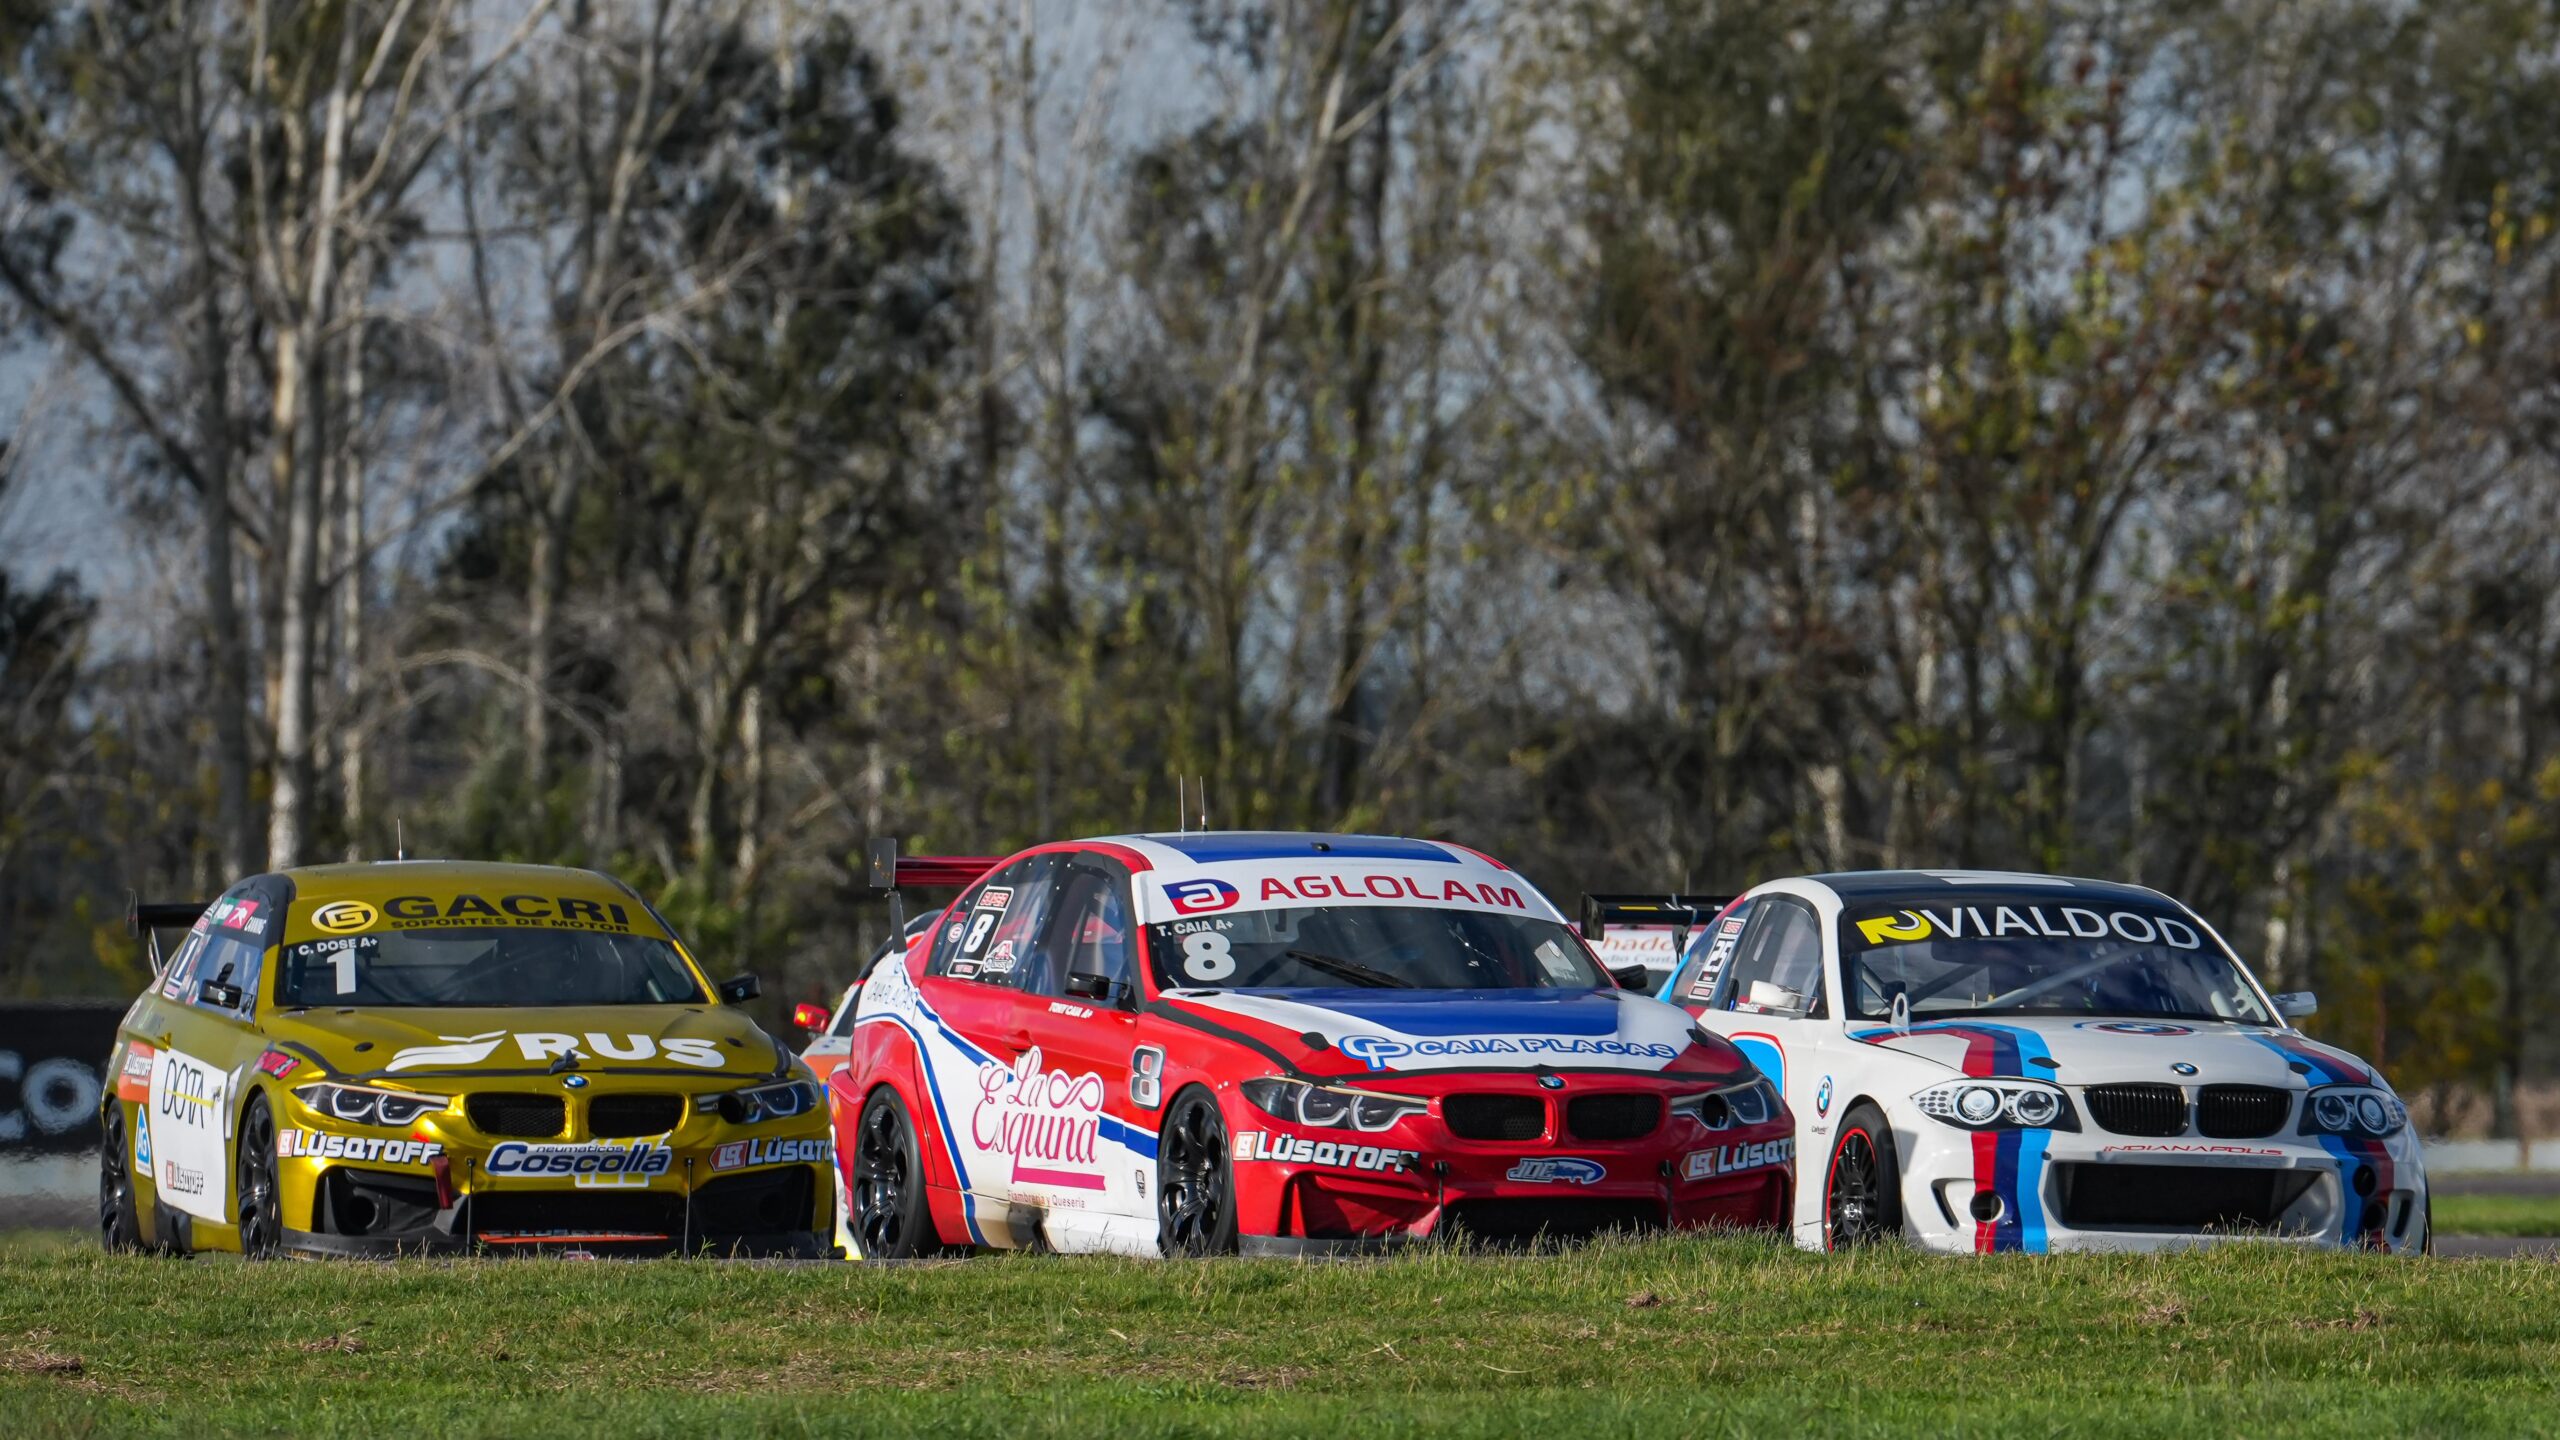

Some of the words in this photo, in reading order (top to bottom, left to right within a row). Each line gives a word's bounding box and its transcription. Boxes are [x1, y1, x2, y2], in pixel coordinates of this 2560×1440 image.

[383, 894, 629, 925] GACRI
[1261, 875, 1526, 909] AGLOLAM
[391, 917, 508, 929] SOPORTES
[515, 918, 545, 926] DE
[551, 919, 630, 932] MOTOR
[963, 913, 995, 953] 8
[1156, 926, 1172, 937] T.
[1174, 920, 1213, 935] CAIA
[1216, 919, 1234, 931] A+
[1920, 906, 2200, 950] VIALDOD
[298, 945, 315, 956] C.
[317, 938, 357, 953] DOSE
[360, 937, 378, 948] A+
[1182, 932, 1237, 981] 8
[326, 948, 357, 995] 1
[513, 1032, 726, 1068] RUS
[1416, 1037, 1515, 1056] CAIA
[1518, 1037, 1680, 1059] PLACAS
[1130, 1044, 1165, 1111] 8
[292, 1130, 442, 1165] LÜSQTOFF
